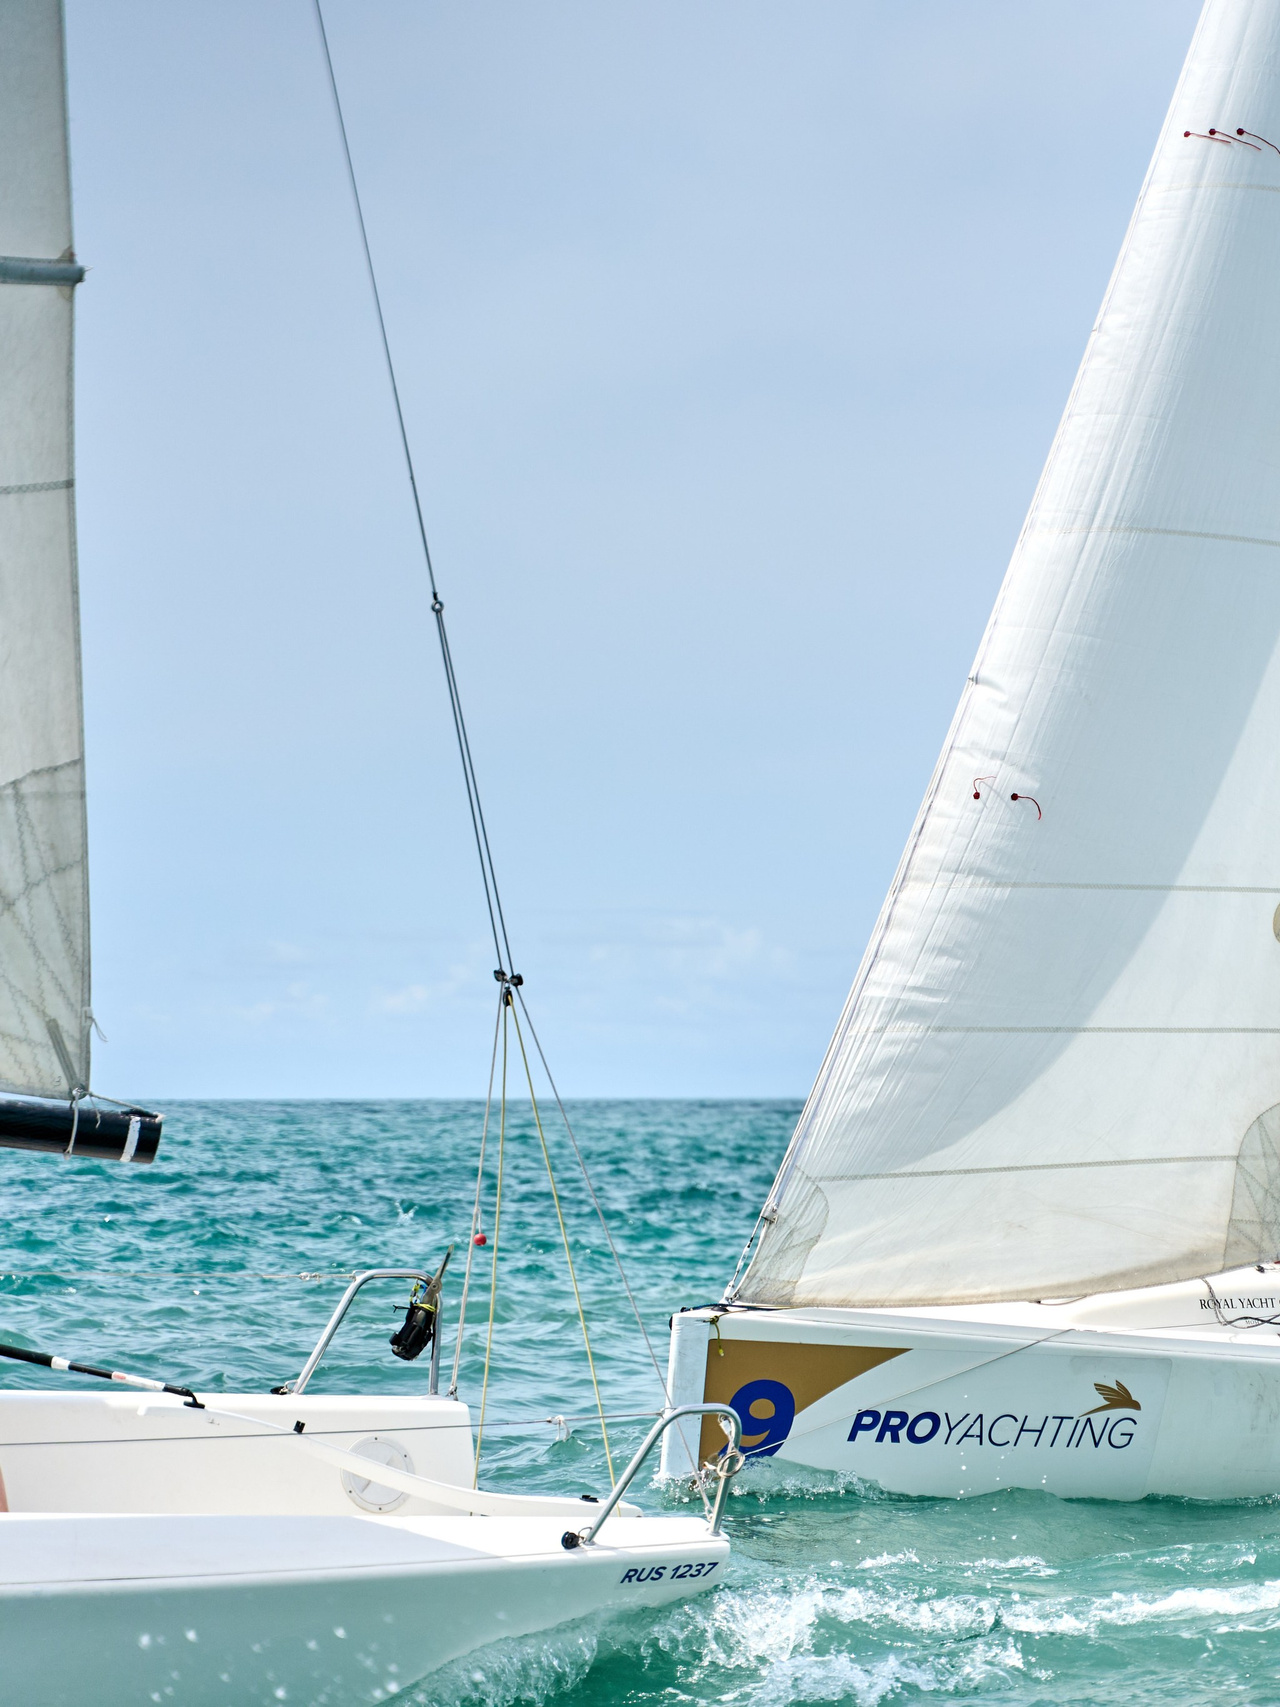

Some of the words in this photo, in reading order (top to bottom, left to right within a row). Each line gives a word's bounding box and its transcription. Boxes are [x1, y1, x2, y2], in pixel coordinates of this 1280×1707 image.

[1199, 1299, 1237, 1310] ROYAL
[1238, 1298, 1275, 1309] YACHT
[717, 1378, 795, 1459] 9
[847, 1409, 1140, 1450] PROYACHTING
[620, 1566, 667, 1584] RUS
[670, 1561, 719, 1580] 1237
